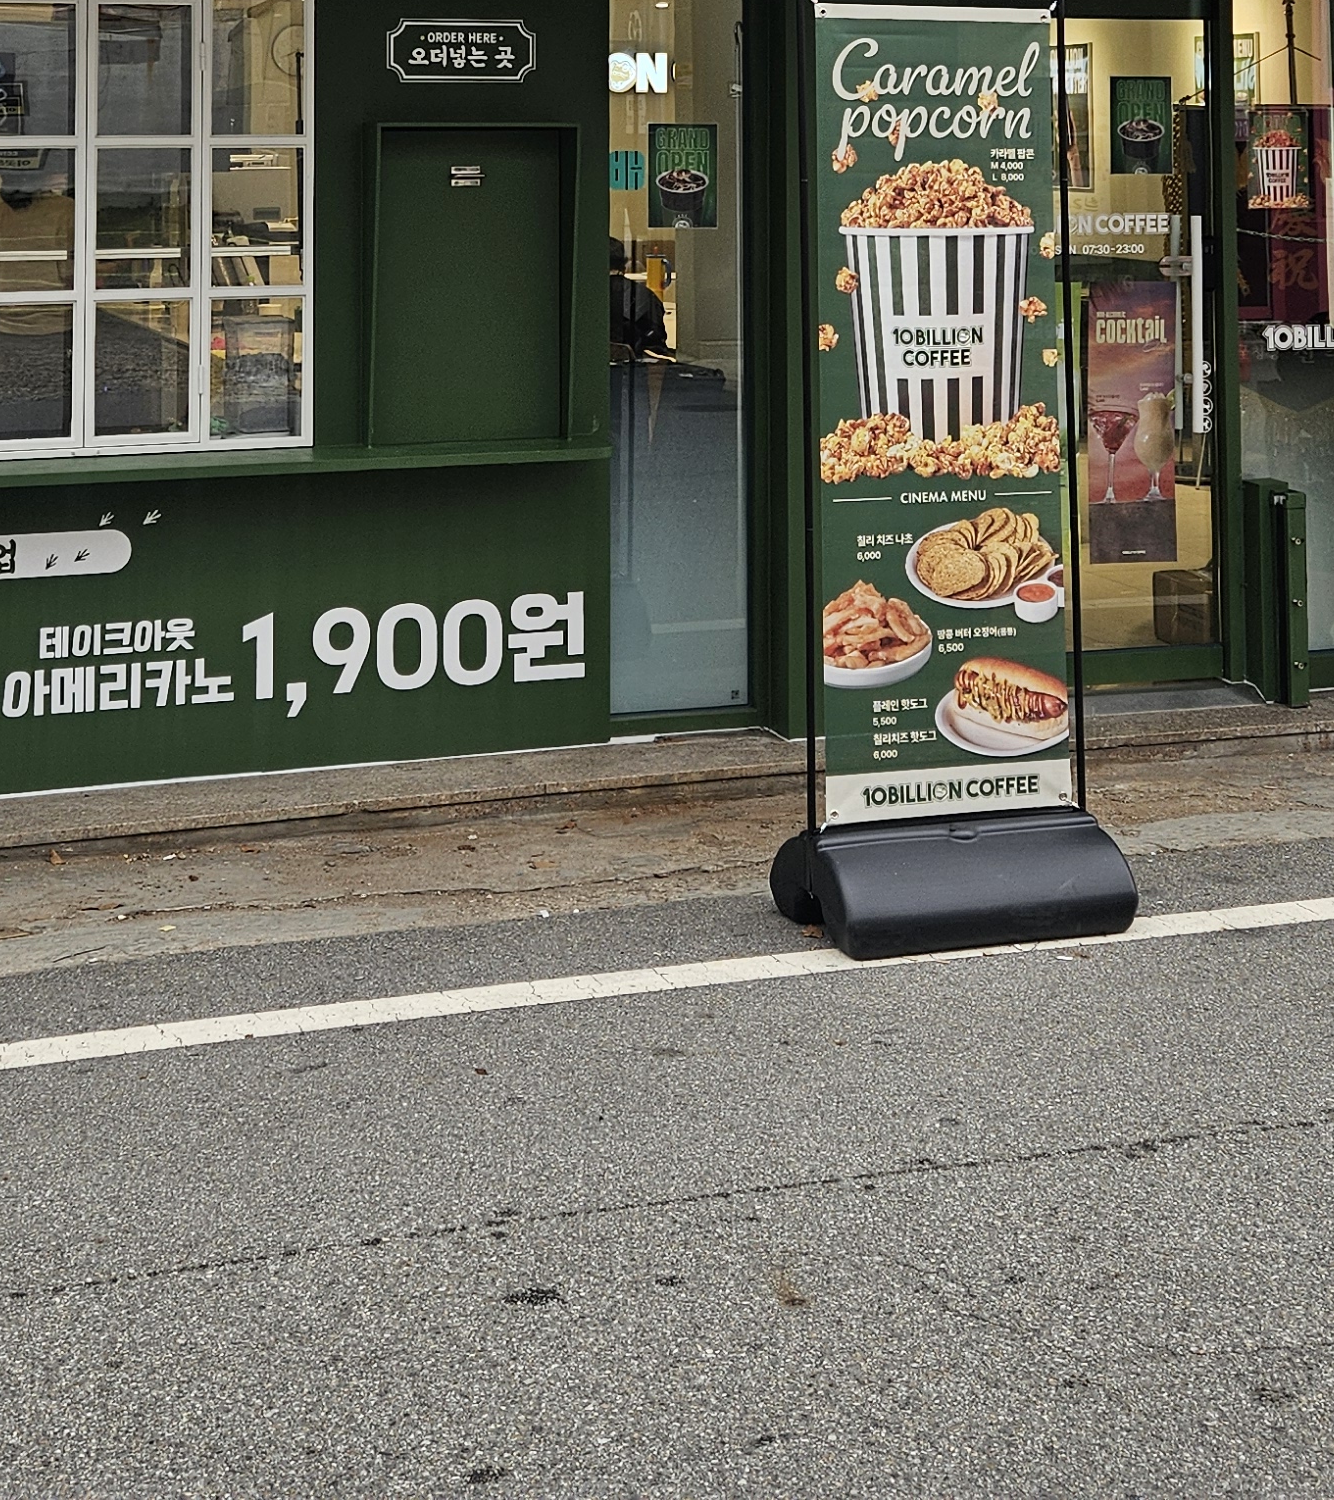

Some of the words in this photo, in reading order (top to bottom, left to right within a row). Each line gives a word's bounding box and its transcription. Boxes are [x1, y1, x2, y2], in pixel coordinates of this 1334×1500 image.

[428, 32, 465, 43] ORDER
[469, 33, 497, 43] HERE
[408, 45, 488, 68] 오더넣는
[494, 46, 515, 68] 곳
[832, 38, 1040, 100] Caramel
[1117, 80, 1165, 100] GRAND
[656, 128, 710, 150] GRAND
[837, 104, 1032, 161] popcorn
[1000, 162, 1023, 171] 4,000
[992, 173, 997, 181] L
[1095, 214, 1169, 235] COFFEE
[891, 327, 984, 346] 10BILLION
[903, 349, 971, 367] COFFEE
[900, 492, 948, 504] CINEMA
[951, 490, 986, 502] MENU
[857, 535, 874, 547] 칠리
[877, 534, 894, 546] 치즈
[896, 533, 913, 545] 나초
[857, 551, 881, 562] 6,000
[38, 615, 196, 660] 테이크아웃
[937, 629, 953, 639] 땅콩
[955, 628, 971, 638] 버터
[2, 662, 236, 719] 아메리카노
[241, 590, 586, 718] 1,900원
[938, 643, 964, 654] 6,500
[873, 700, 899, 712] 플레인
[901, 698, 928, 711] 핫도그
[873, 716, 897, 727] 5,500
[874, 732, 909, 745] 칠리치즈
[910, 731, 937, 743] 핫도그
[874, 749, 898, 760] 6,000
[862, 781, 963, 808] 10BILLION
[966, 776, 1039, 796] COFFEE
